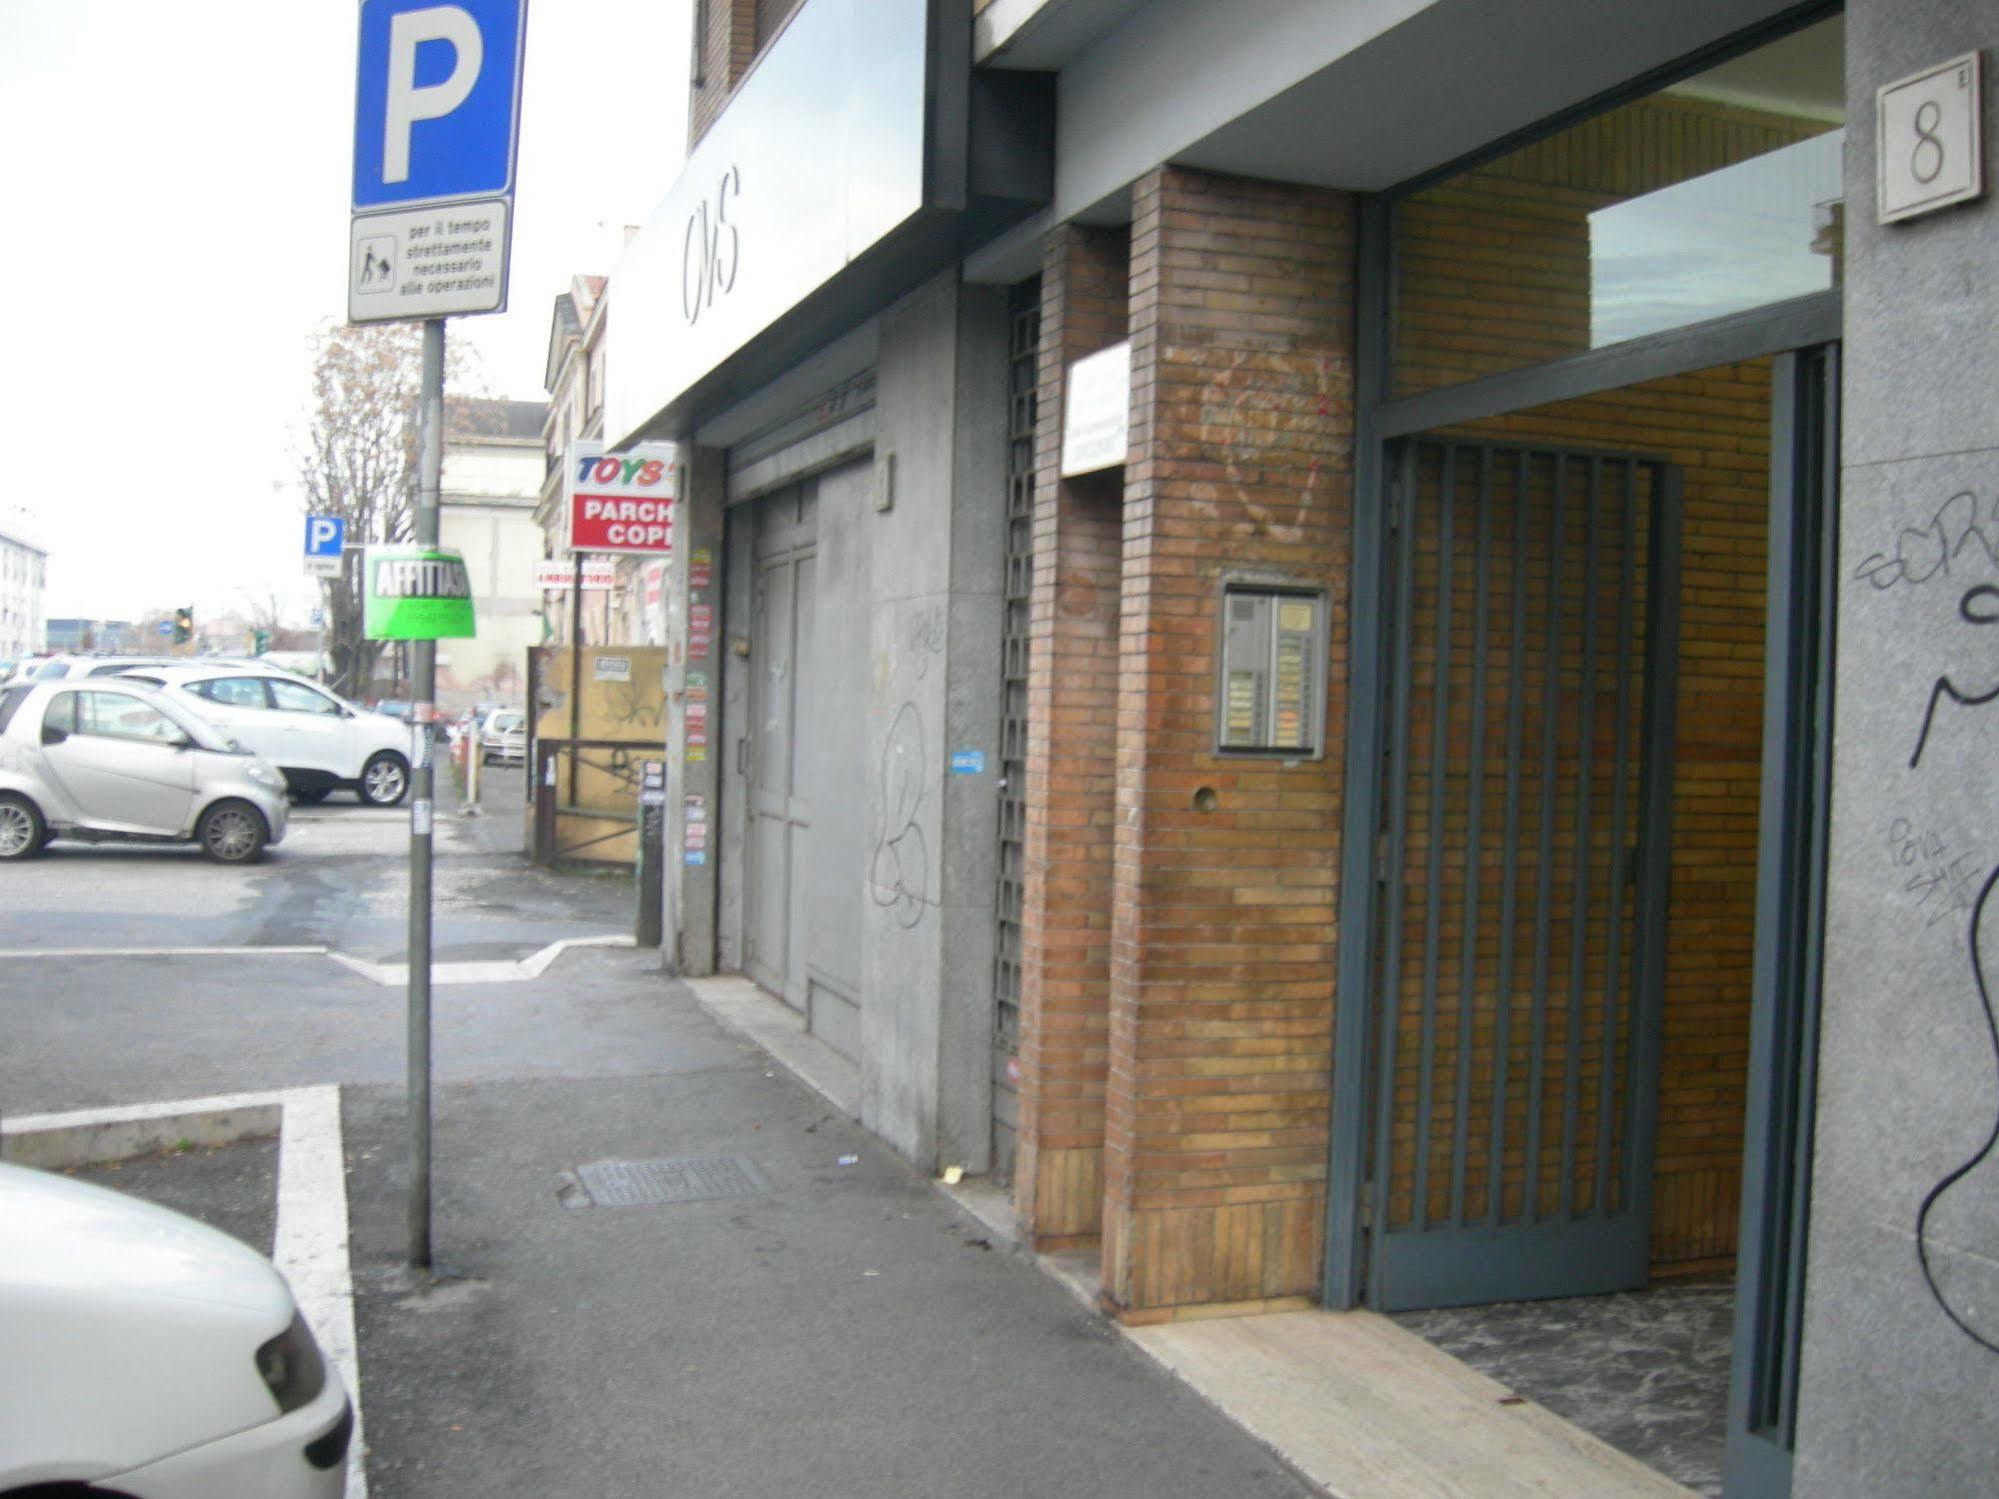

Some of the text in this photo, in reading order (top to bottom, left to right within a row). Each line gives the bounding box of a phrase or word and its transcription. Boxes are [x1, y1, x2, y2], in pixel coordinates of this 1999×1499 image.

[383, 5, 484, 185] P
[1910, 100, 1945, 185] 8
[409, 217, 491, 241] per il tempo
[406, 240, 492, 260] strettamente
[412, 258, 483, 277] necessario
[400, 274, 496, 297] alle operazioni
[578, 456, 664, 487] TOYS
[584, 500, 673, 523] PARCH
[311, 519, 337, 553] P
